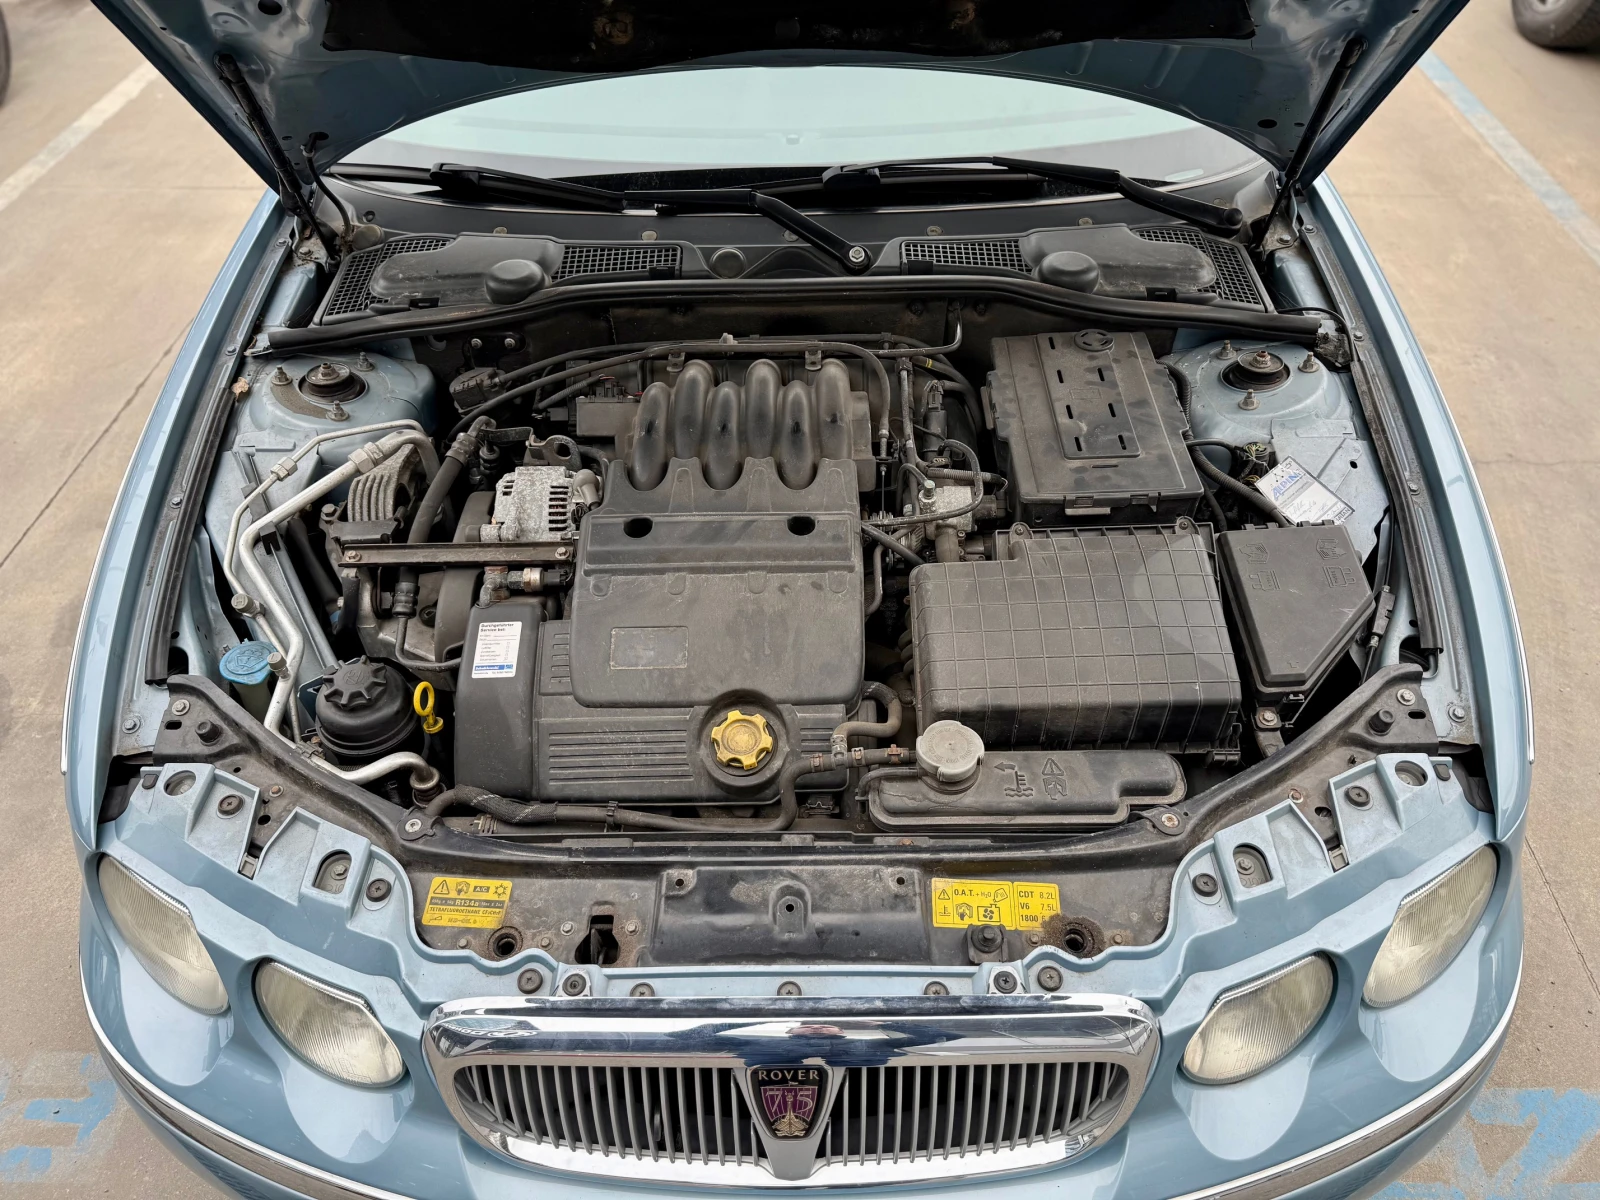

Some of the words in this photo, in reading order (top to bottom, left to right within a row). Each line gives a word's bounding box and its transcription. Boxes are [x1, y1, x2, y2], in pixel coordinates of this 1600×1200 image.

[953, 888, 975, 897] O.A.T.
[1018, 890, 1035, 899] CDT
[1039, 891, 1055, 900] 8.2L
[455, 899, 480, 907] R134a
[1020, 902, 1030, 910] V6
[1040, 903, 1057, 912] 7.5L
[1020, 914, 1039, 923] 1800
[758, 1069, 820, 1081] ROVER
[766, 1090, 813, 1113] 75
